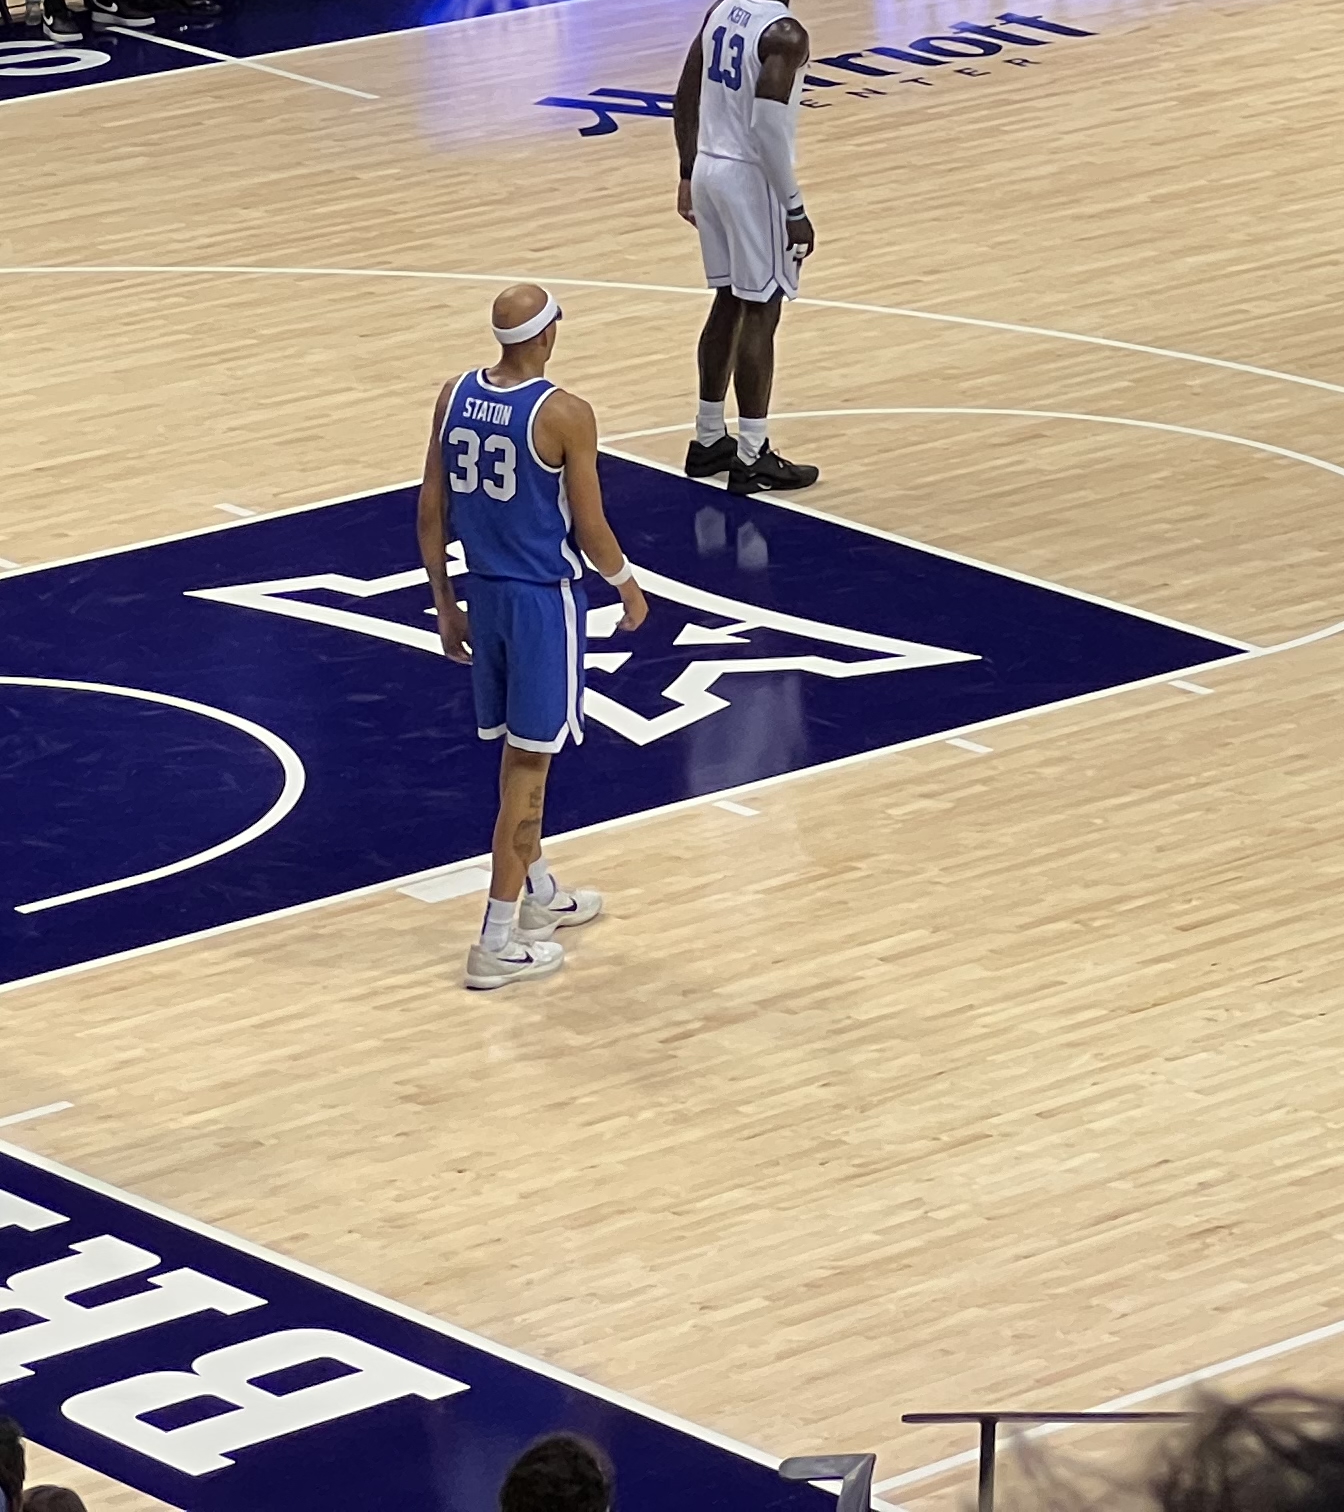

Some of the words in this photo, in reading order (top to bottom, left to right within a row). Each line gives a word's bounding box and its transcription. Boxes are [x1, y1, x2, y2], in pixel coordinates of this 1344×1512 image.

[706, 24, 745, 92] 13
[802, 61, 1043, 110] ENTER
[461, 396, 513, 426] STATON
[448, 426, 519, 503] 33
